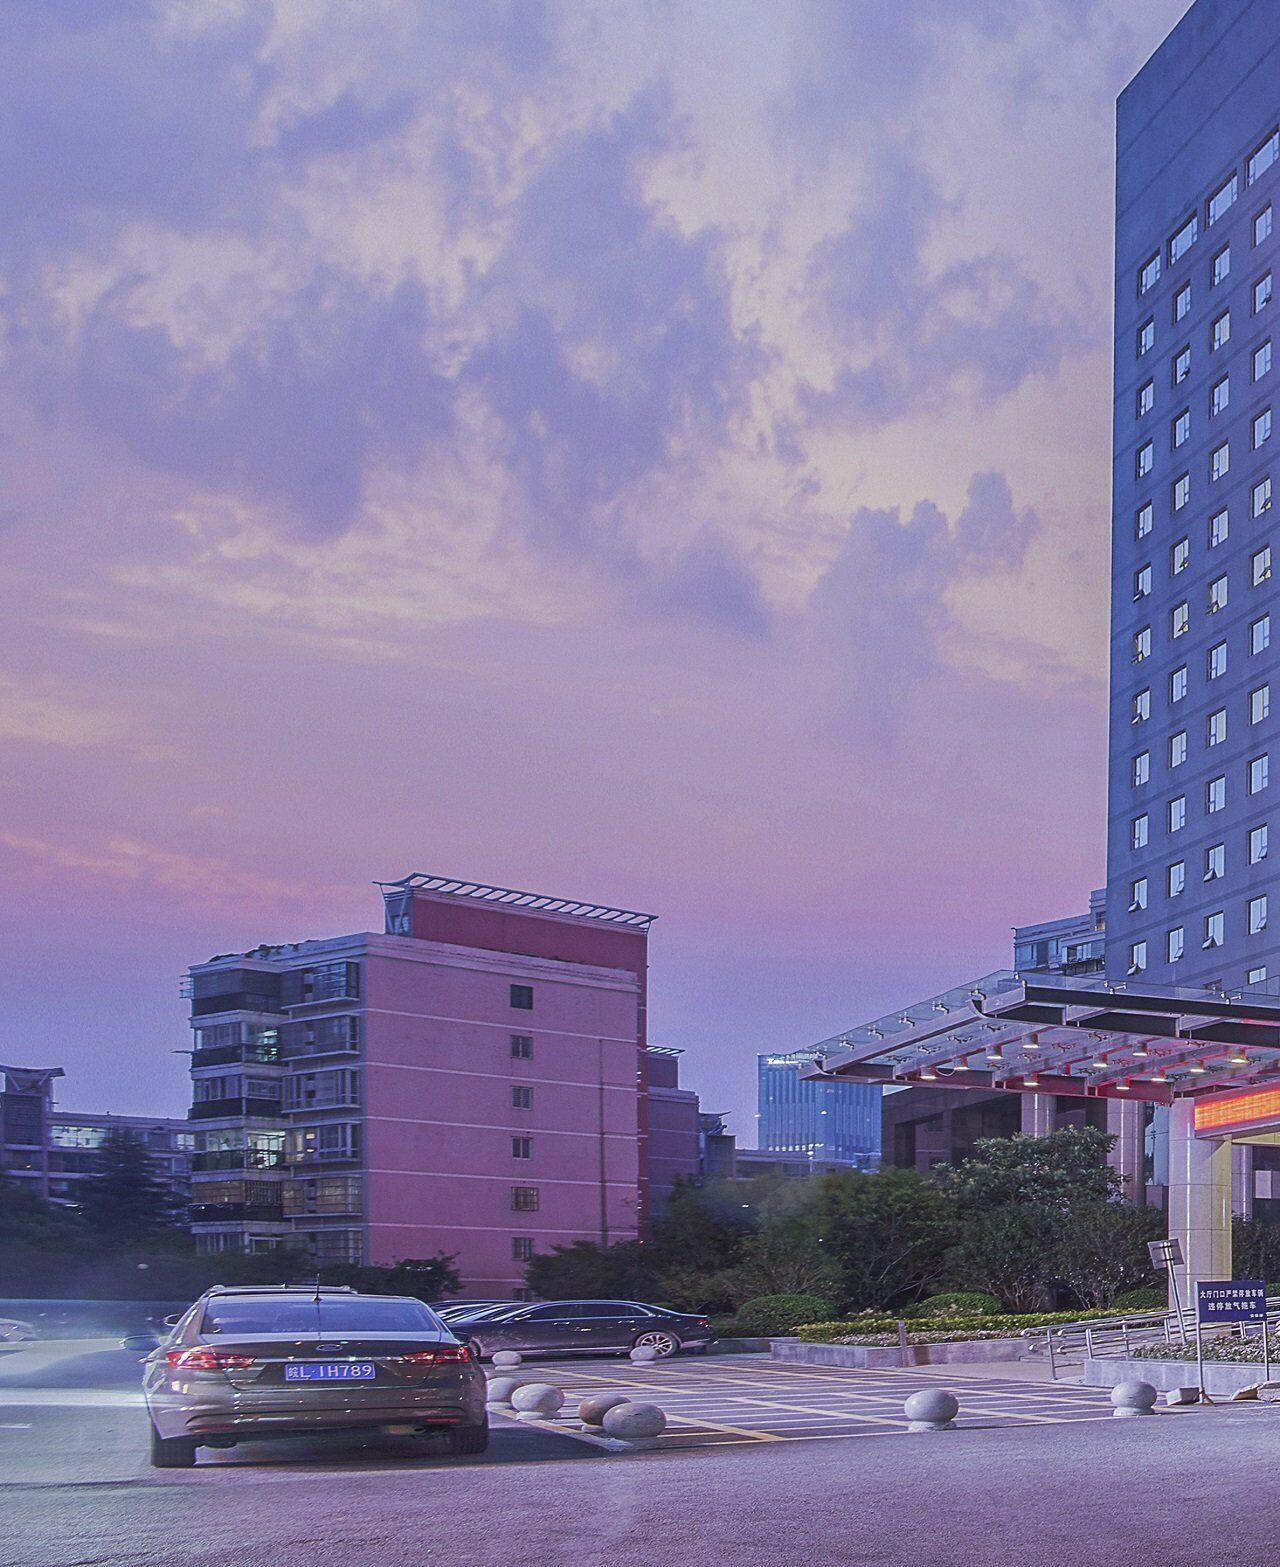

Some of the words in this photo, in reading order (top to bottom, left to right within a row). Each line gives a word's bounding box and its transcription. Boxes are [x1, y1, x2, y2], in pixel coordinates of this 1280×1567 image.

[1199, 1288, 1264, 1299] 大厅门口严禁停放车辆
